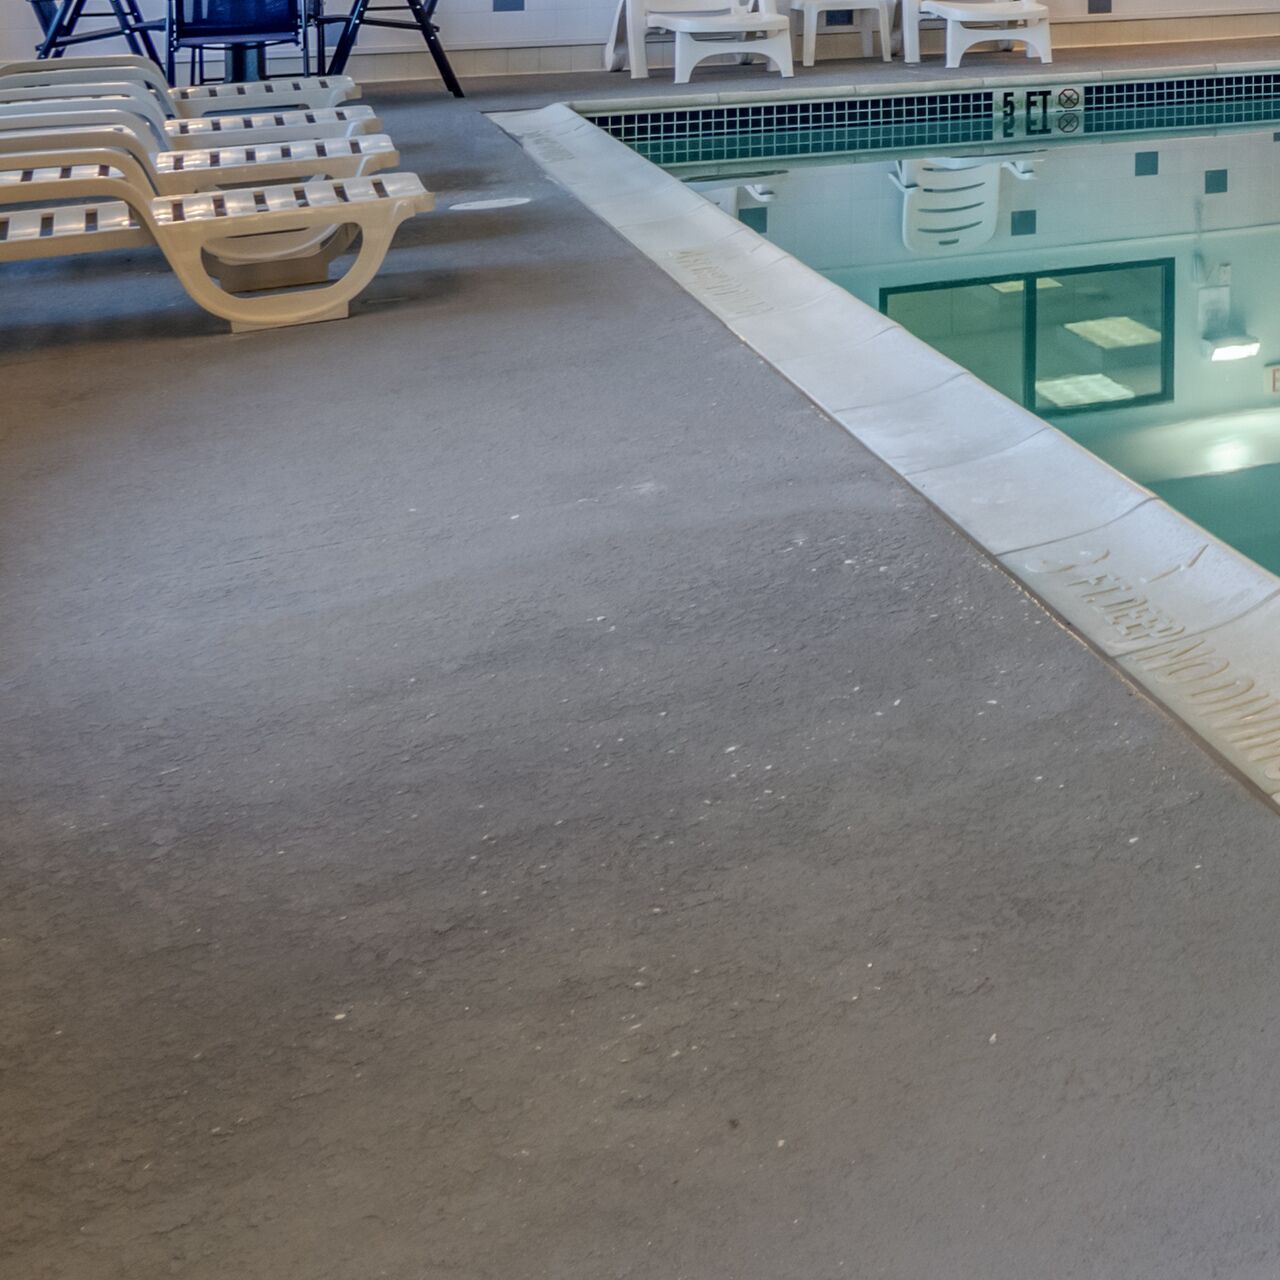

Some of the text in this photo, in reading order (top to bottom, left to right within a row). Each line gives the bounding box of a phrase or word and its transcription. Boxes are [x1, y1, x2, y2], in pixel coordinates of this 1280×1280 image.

[1003, 90, 1052, 116] 5 FT
[1092, 597, 1186, 641] DEEP
[1133, 640, 1231, 684] NO
